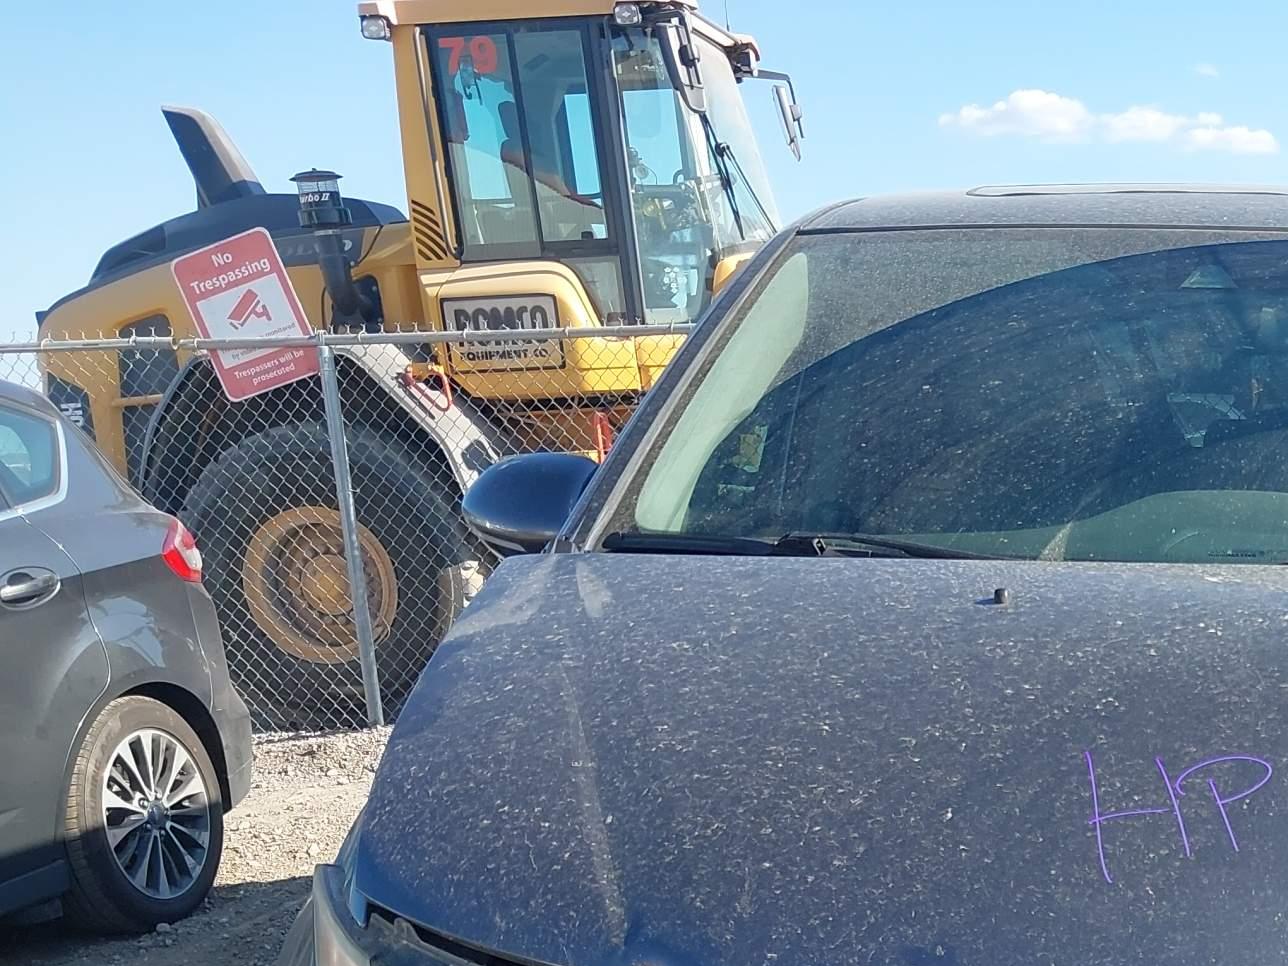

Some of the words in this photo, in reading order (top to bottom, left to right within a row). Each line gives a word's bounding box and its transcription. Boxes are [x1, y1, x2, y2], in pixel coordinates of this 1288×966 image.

[438, 35, 497, 75] 79
[300, 193, 320, 203] urbo
[190, 257, 272, 295] Trespassing
[211, 252, 233, 268] No
[454, 304, 550, 347] ROMCO
[234, 355, 280, 379] Trespassers
[279, 351, 294, 363] will
[294, 349, 305, 359] be
[252, 363, 296, 386] prosecuted
[1084, 751, 1273, 883] HP
